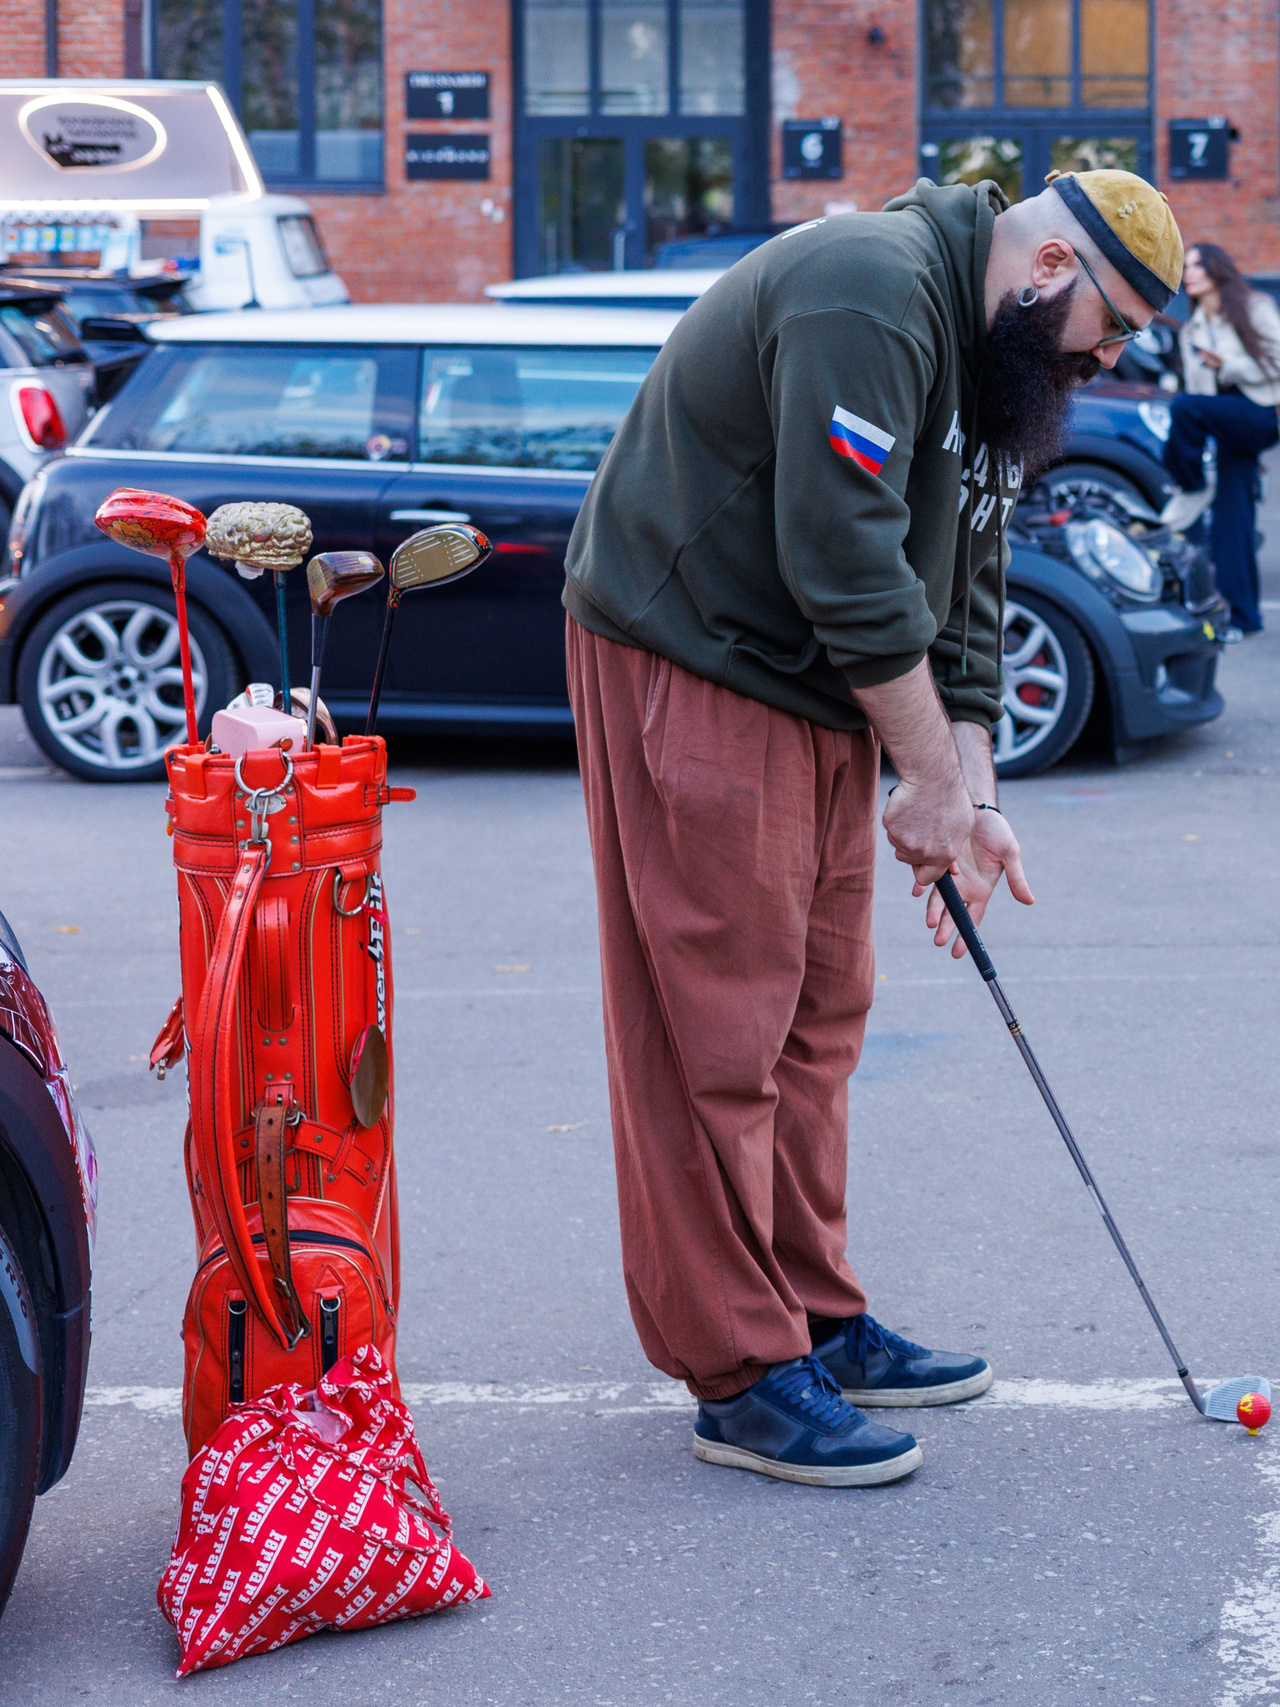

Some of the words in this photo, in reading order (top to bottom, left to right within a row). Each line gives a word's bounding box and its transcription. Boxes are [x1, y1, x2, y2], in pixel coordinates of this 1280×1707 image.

[801, 132, 823, 160] 6
[1187, 132, 1209, 160] 7
[212, 1418, 274, 1487] Ferrari
[239, 1472, 293, 1544] Ferrari
[291, 1507, 333, 1568] errari
[199, 1505, 239, 1585] Ferrari
[238, 1529, 288, 1605] Ferrari
[334, 1522, 388, 1599] Frrari
[280, 1546, 344, 1615] Ferrari
[367, 1552, 428, 1621] Ferrari
[225, 1583, 290, 1657] Ferrari
